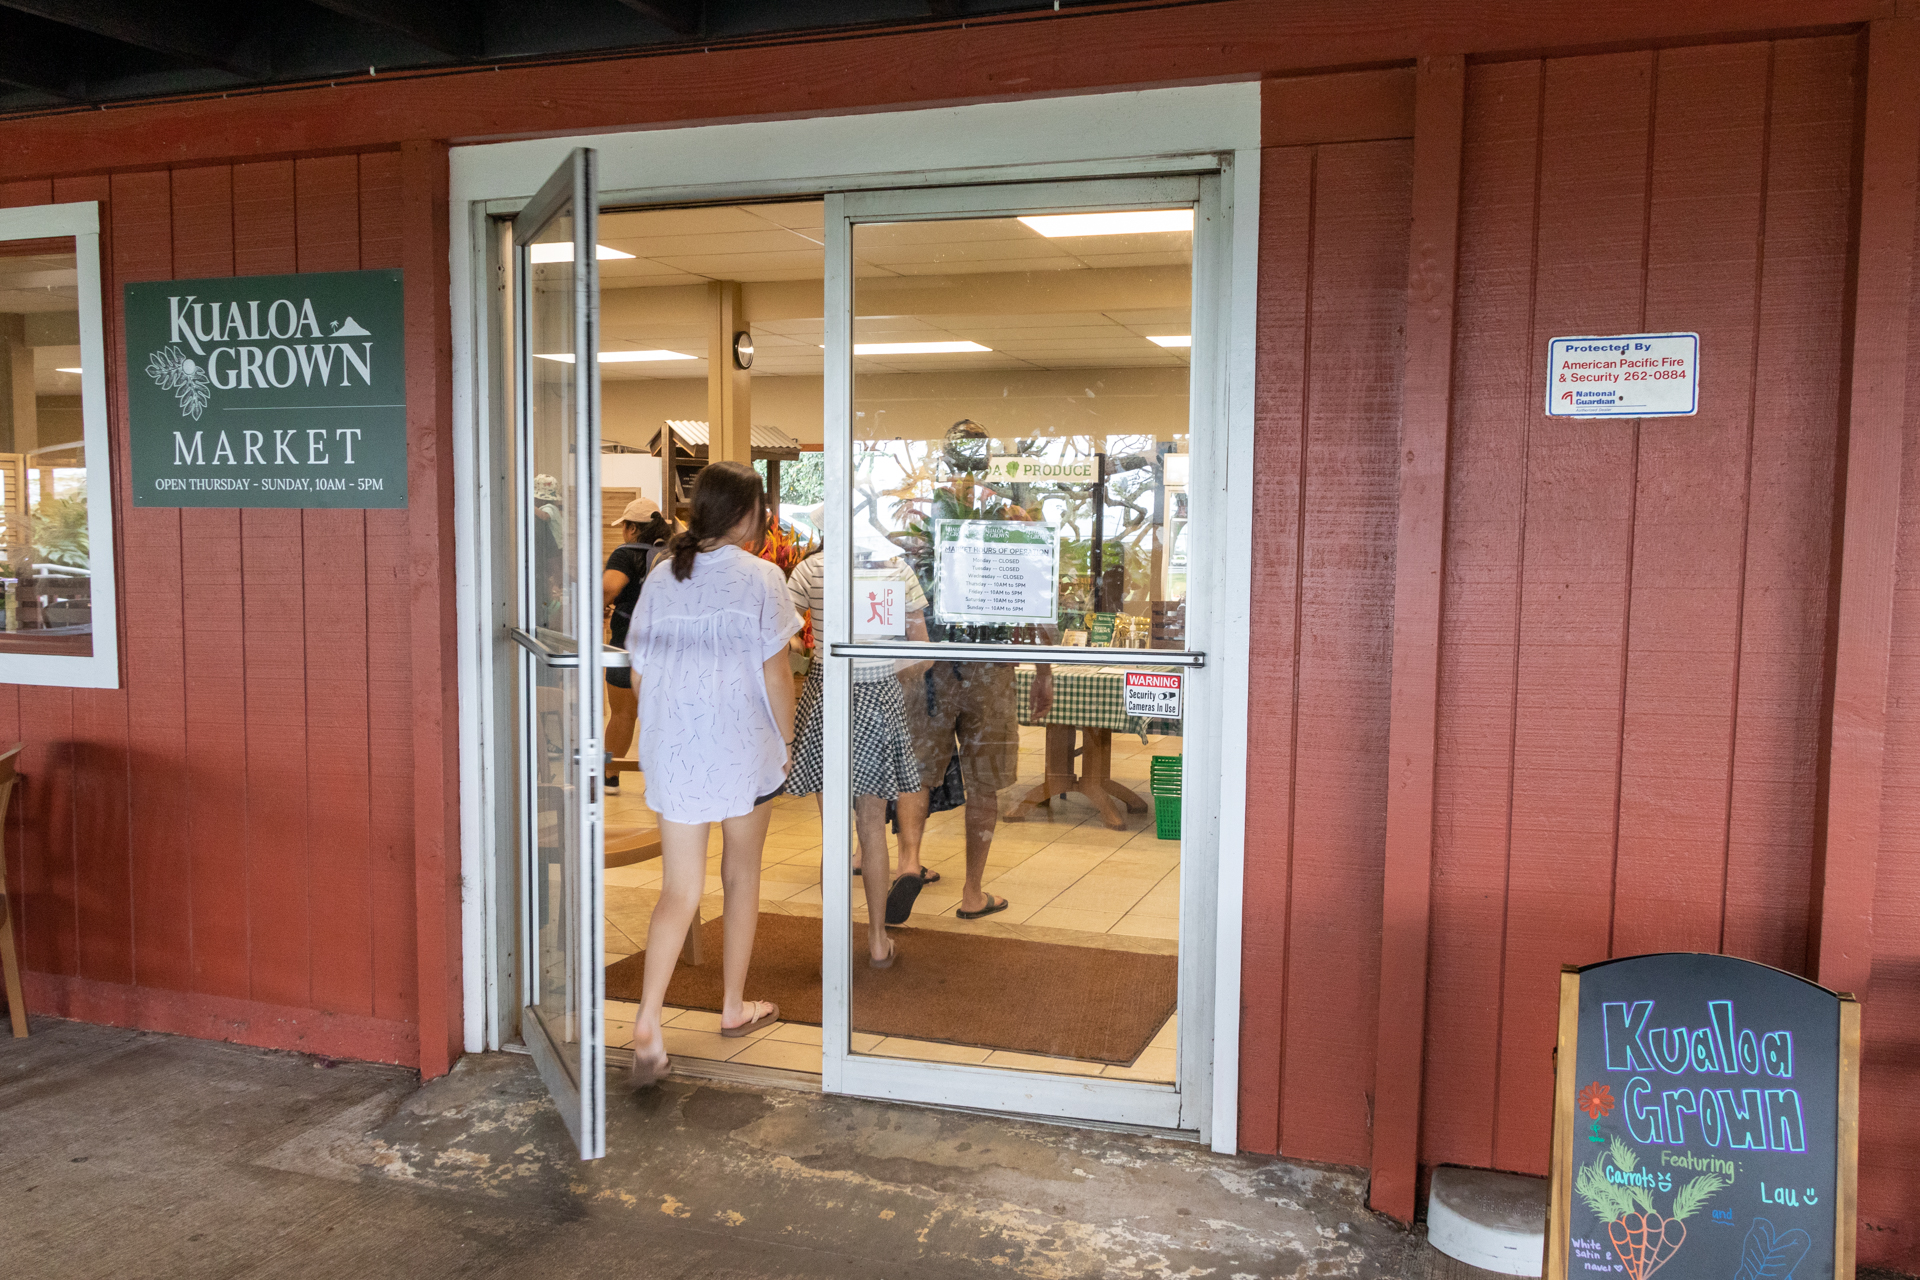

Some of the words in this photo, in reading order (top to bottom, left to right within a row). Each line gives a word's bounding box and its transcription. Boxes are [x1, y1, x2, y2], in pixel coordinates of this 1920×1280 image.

[168, 296, 324, 355] KUALOA
[1566, 343, 1629, 352] Protected
[1635, 343, 1651, 351] By
[208, 342, 373, 390] GROWN
[1562, 360, 1617, 370] American
[1620, 358, 1659, 368] Pacific
[1662, 357, 1684, 367] Fire
[1559, 373, 1567, 383] &
[1571, 372, 1619, 384] Security
[1624, 370, 1687, 381] 262-0884
[1576, 398, 1616, 406] Guardian
[173, 428, 361, 466] MARKET
[1023, 464, 1092, 476] PRODUCE
[155, 478, 187, 490] OPEN
[189, 478, 250, 490] THURSDAY
[261, 478, 313, 492] SUNDAY,
[315, 478, 346, 490] 10AM
[357, 478, 383, 490] 5PM
[1129, 674, 1178, 687] WARNING
[1128, 689, 1156, 702] Security
[1128, 700, 1155, 712] Cameras
[1157, 703, 1163, 712] In
[1165, 703, 1176, 713] Use
[1602, 1000, 1795, 1078] Kualoa
[1623, 1076, 1807, 1153] Grown
[1606, 1165, 1655, 1188] Carrots
[1761, 1181, 1799, 1207] Lau
[1712, 1207, 1732, 1220] and
[1571, 1237, 1601, 1250] White
[1584, 1262, 1611, 1272] navel
